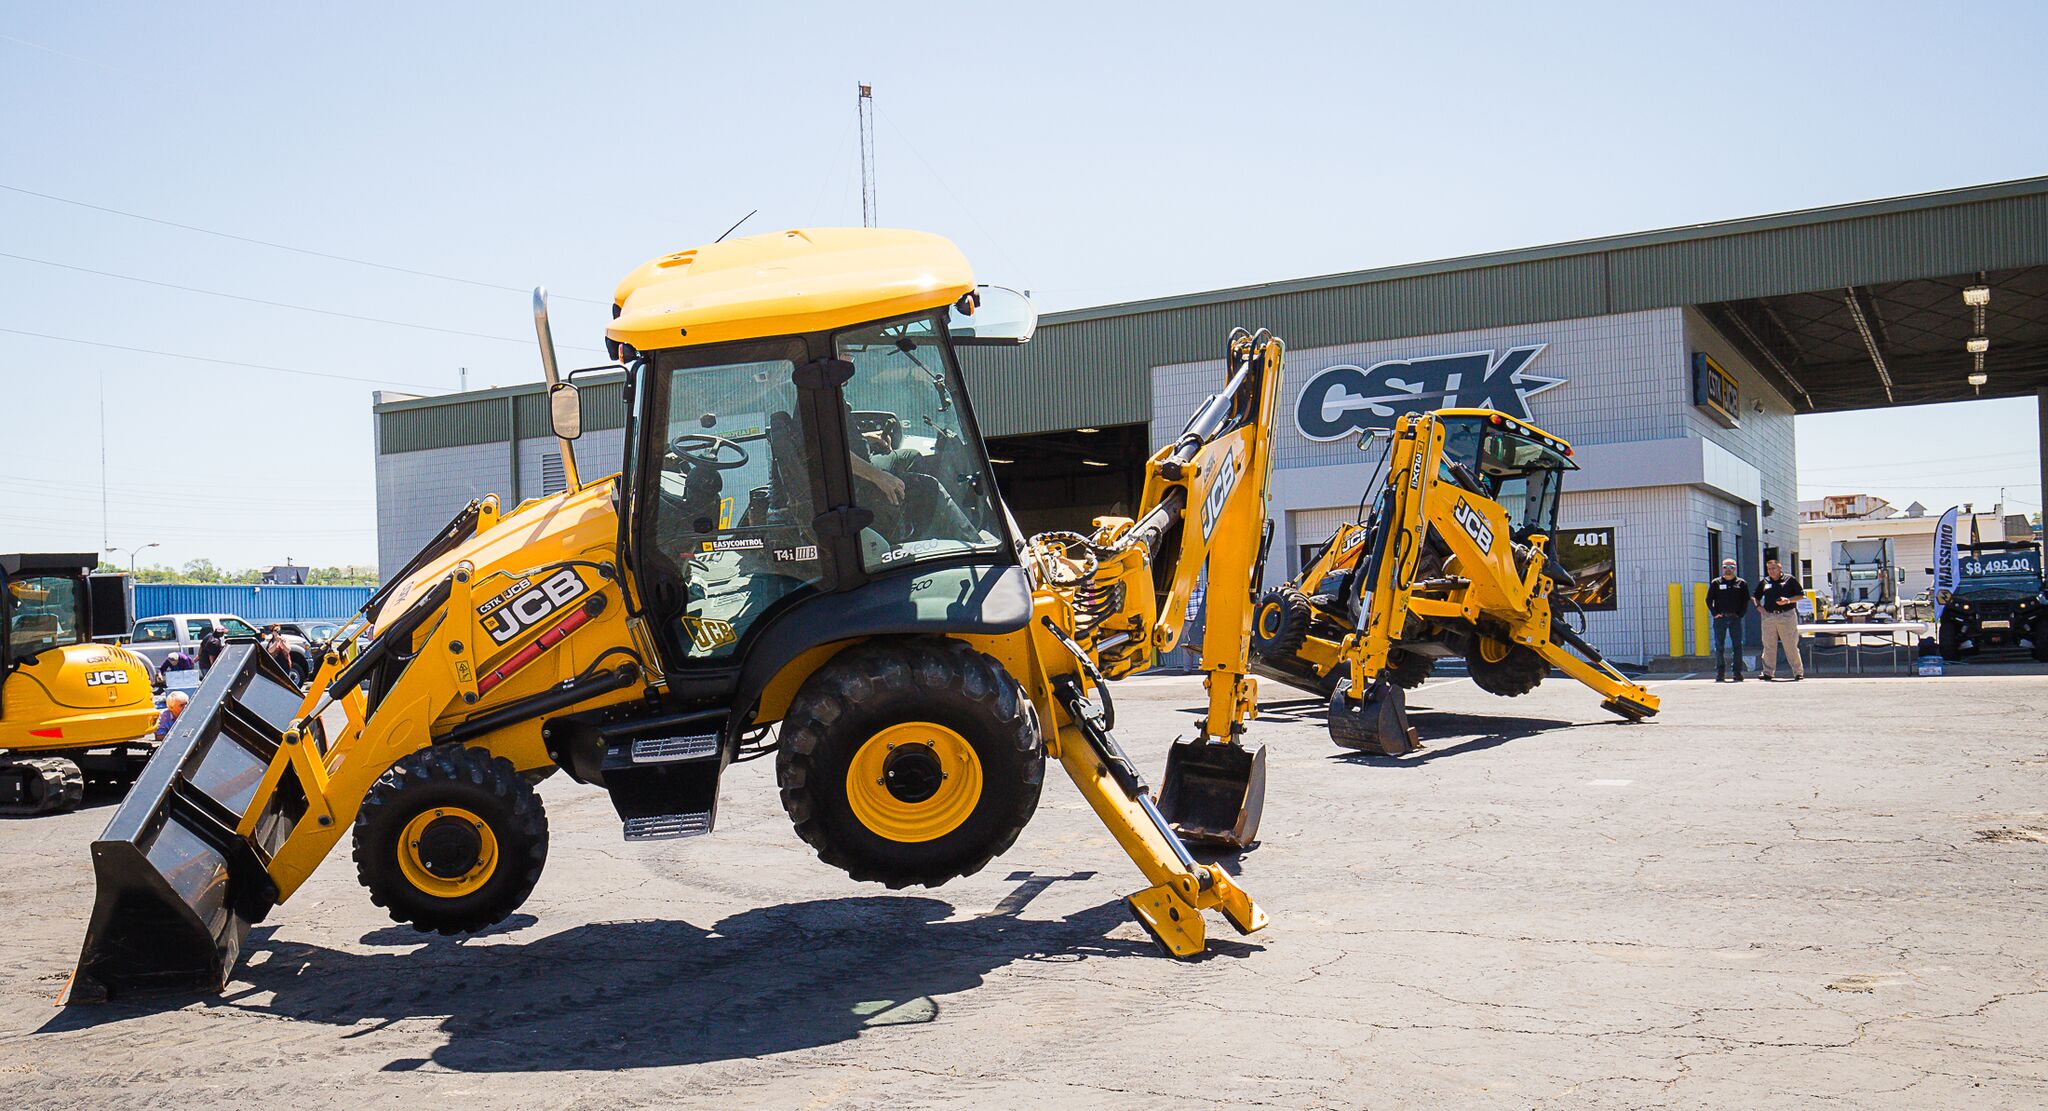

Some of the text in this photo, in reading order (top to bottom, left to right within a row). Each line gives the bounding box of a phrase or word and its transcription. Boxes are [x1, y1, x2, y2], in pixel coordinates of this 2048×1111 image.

[1296, 346, 1563, 441] CSTK
[1203, 452, 1236, 540] JCB
[713, 538, 764, 549] EASYCONTROL
[1456, 504, 1493, 554] JCB
[1573, 532, 1608, 547] 401
[774, 549, 794, 561] T4i
[1938, 523, 1953, 588] MASSIMO
[479, 578, 531, 614] CSTK JCB
[492, 570, 584, 642] JCB
[690, 619, 735, 649] JCB
[87, 670, 129, 686] JCB
